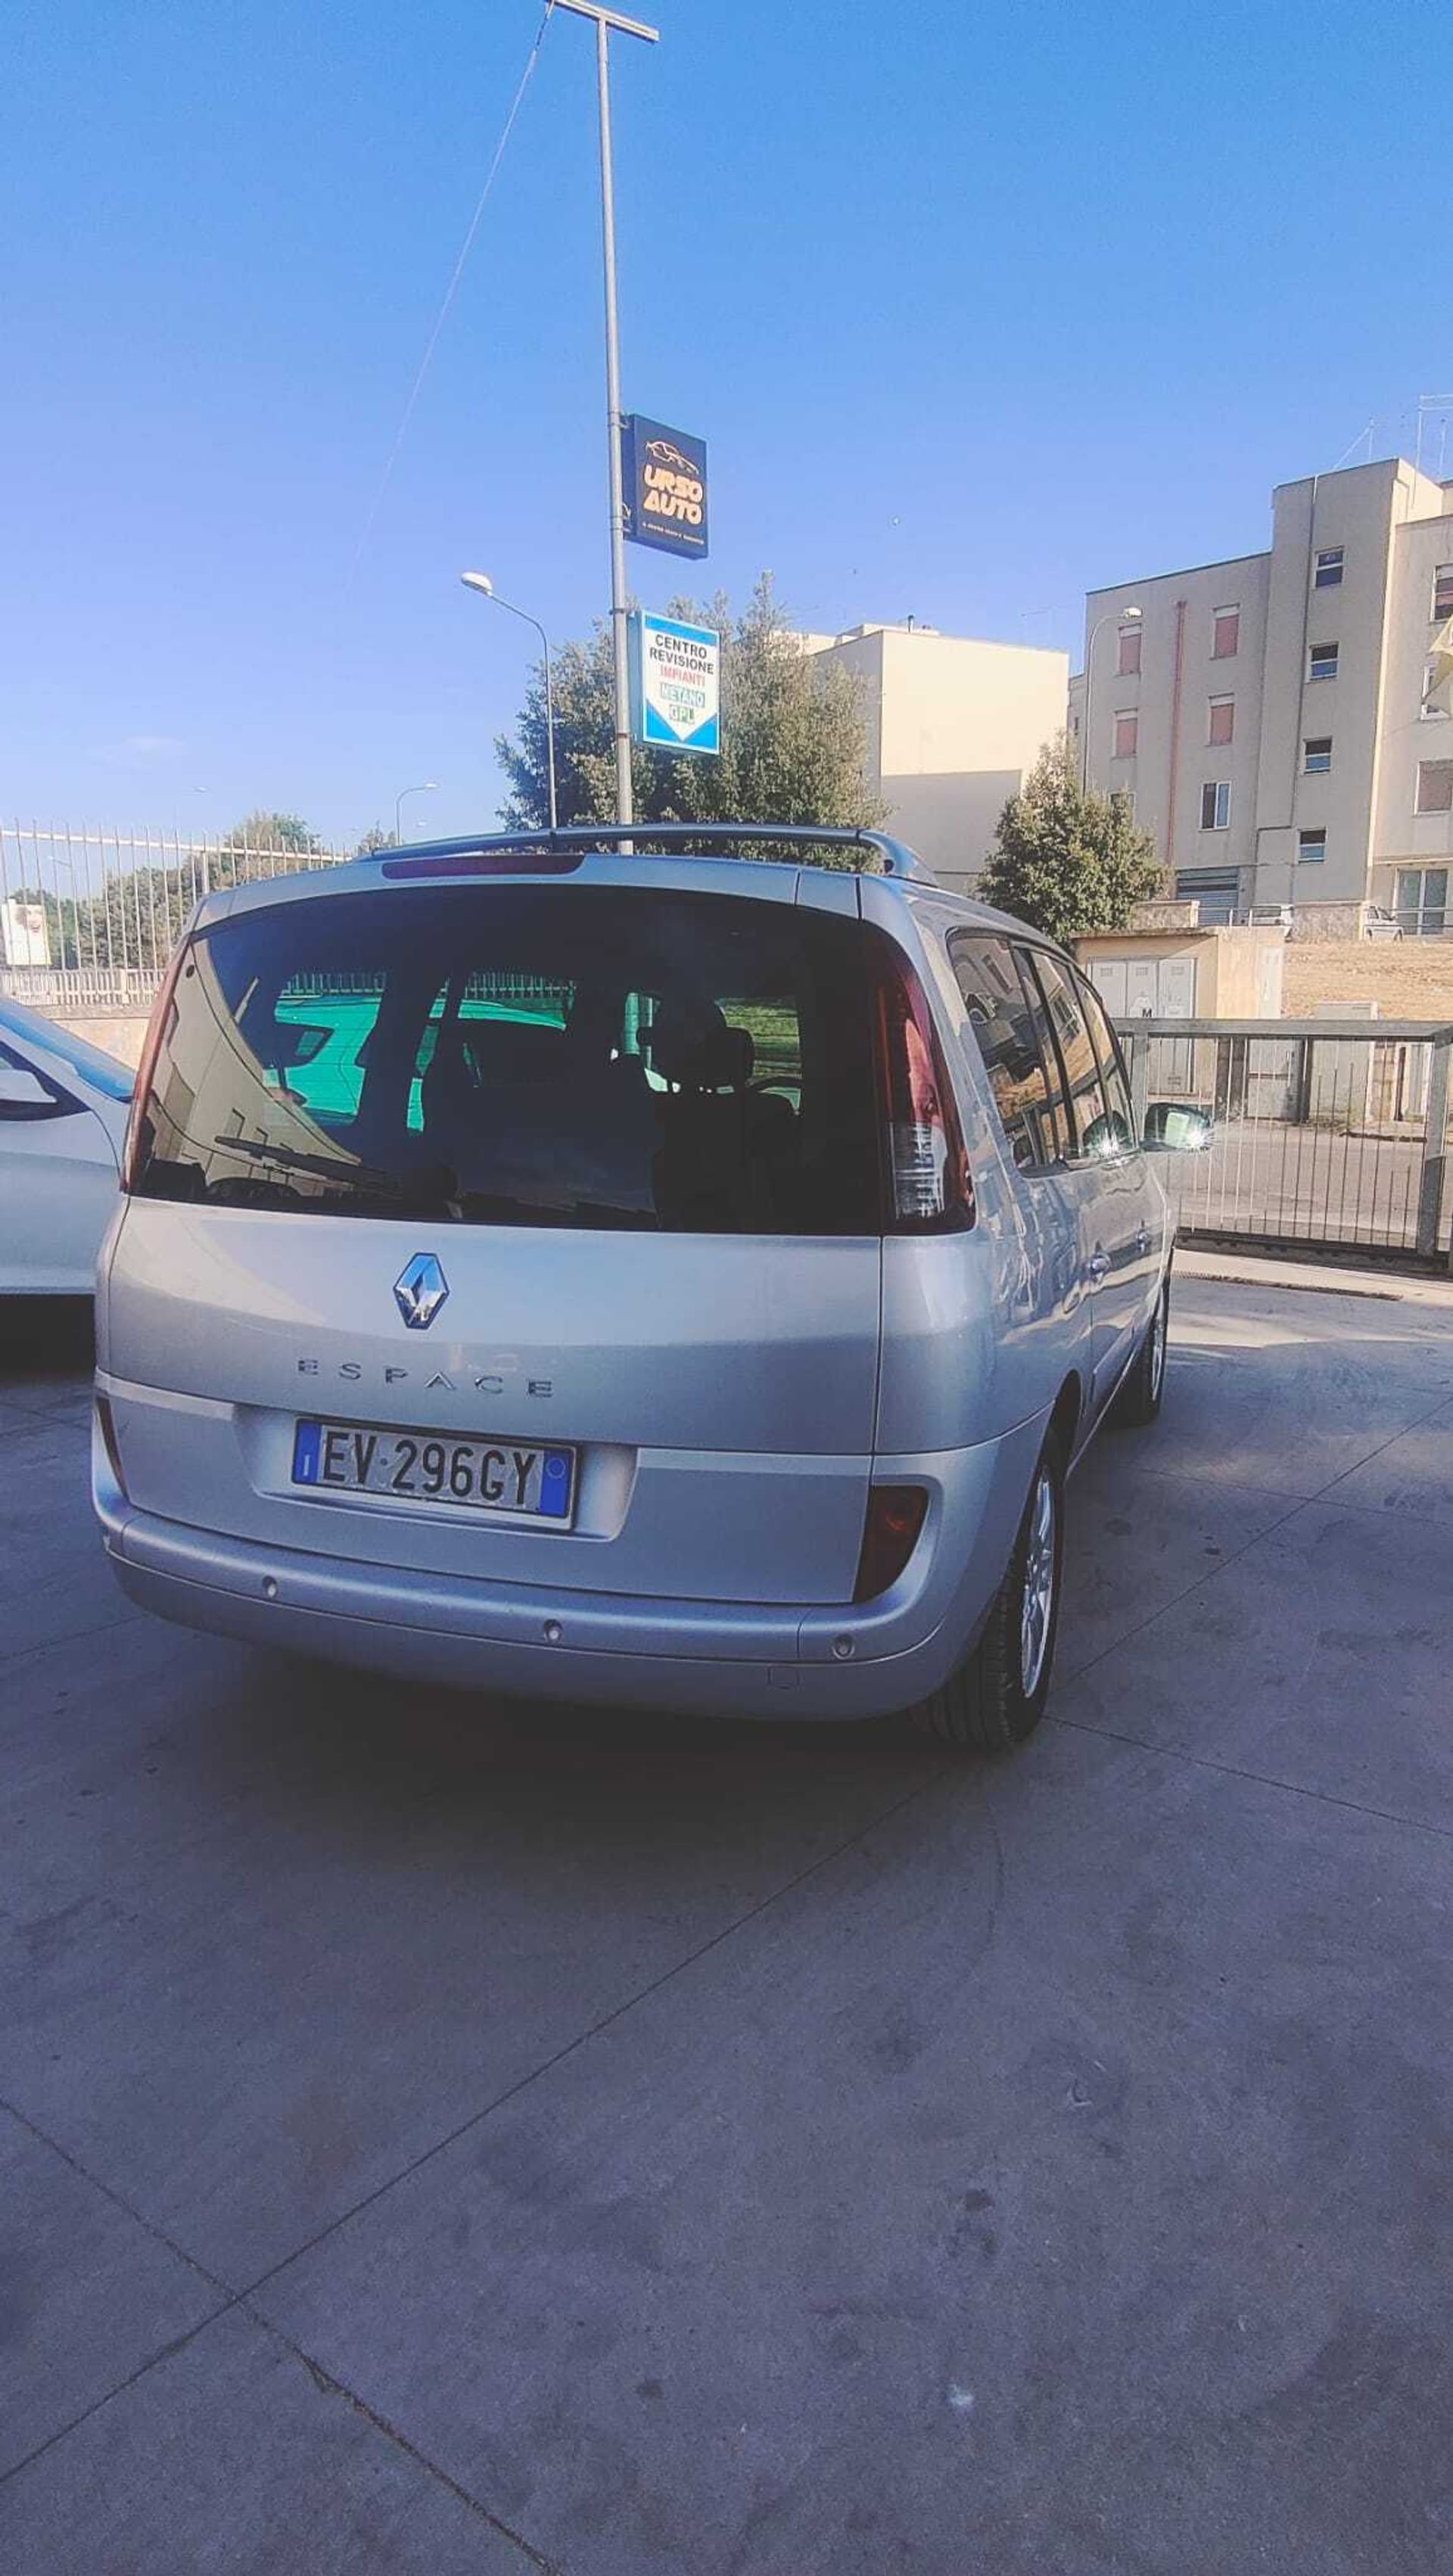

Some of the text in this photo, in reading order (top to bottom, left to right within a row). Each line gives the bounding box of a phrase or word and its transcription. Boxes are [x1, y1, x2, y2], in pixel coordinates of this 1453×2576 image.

[644, 464, 703, 503] URSO
[643, 490, 702, 524] AUTO
[649, 647, 714, 674] REVISIONE
[655, 634, 708, 659] CENTRO
[661, 665, 705, 686] IMPIANTI
[661, 682, 705, 708] METANO
[297, 1359, 554, 1398] ESPACE
[322, 1430, 377, 1485] EV
[391, 1439, 537, 1504] 296GY
